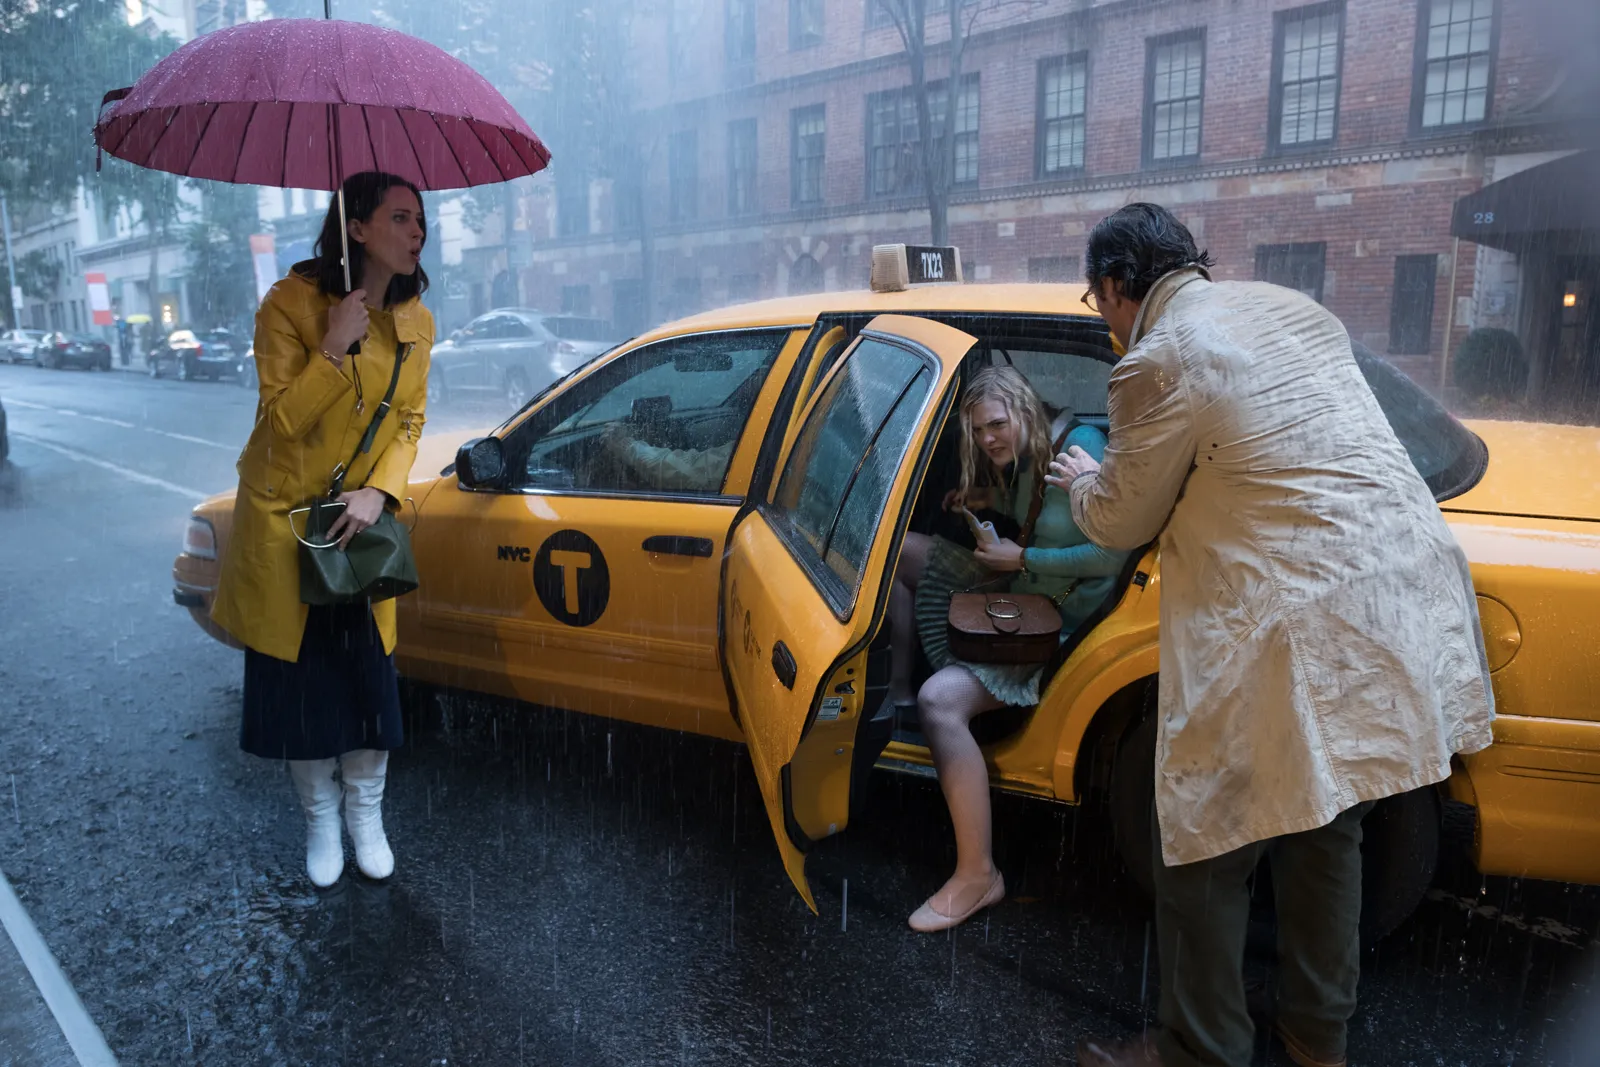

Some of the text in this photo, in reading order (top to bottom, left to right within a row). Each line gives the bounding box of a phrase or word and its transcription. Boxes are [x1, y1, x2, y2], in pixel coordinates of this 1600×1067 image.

[1474, 211, 1494, 224] 28
[921, 252, 943, 279] 7X23
[497, 545, 592, 615] NYC T
